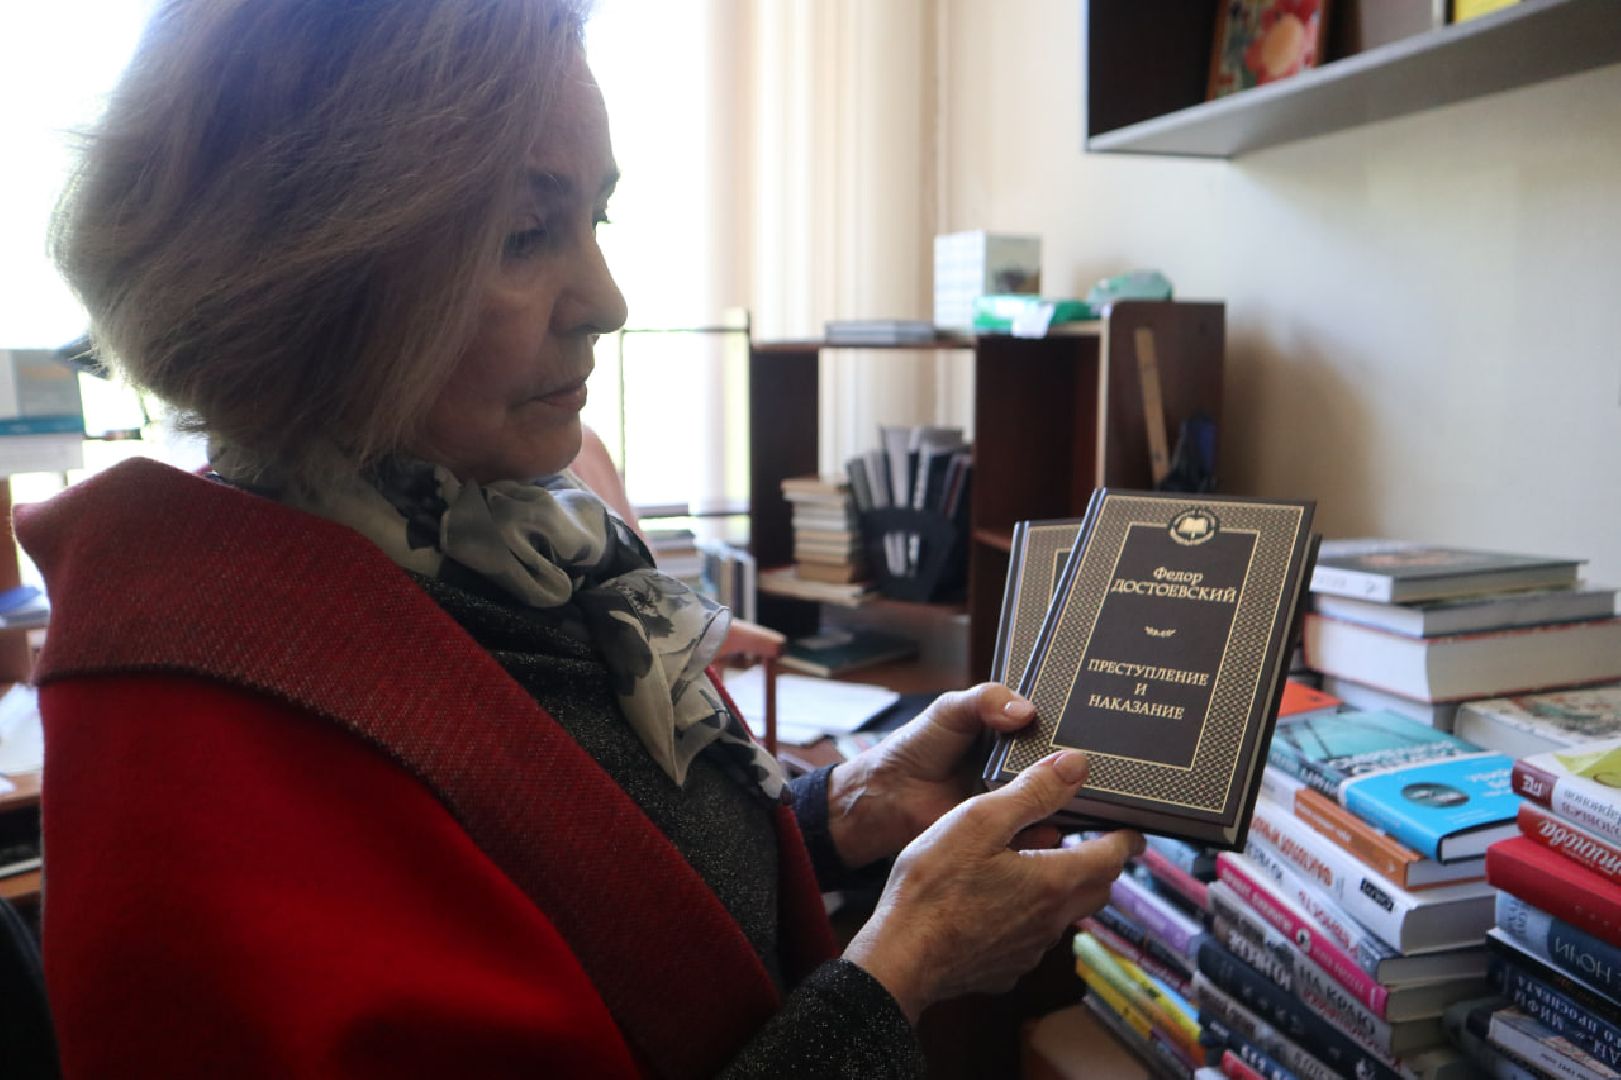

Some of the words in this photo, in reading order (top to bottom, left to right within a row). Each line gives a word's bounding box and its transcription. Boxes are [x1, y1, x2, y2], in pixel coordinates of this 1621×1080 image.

[1153, 566, 1204, 585] Федор
[1110, 578, 1238, 602] ДОСТОЕВСКИЙ
[1086, 658, 1210, 687] ПРЕСТУПЛЕНИЕ
[1133, 682, 1149, 696] И
[1088, 694, 1185, 720] НАКАЗАНИЕ
